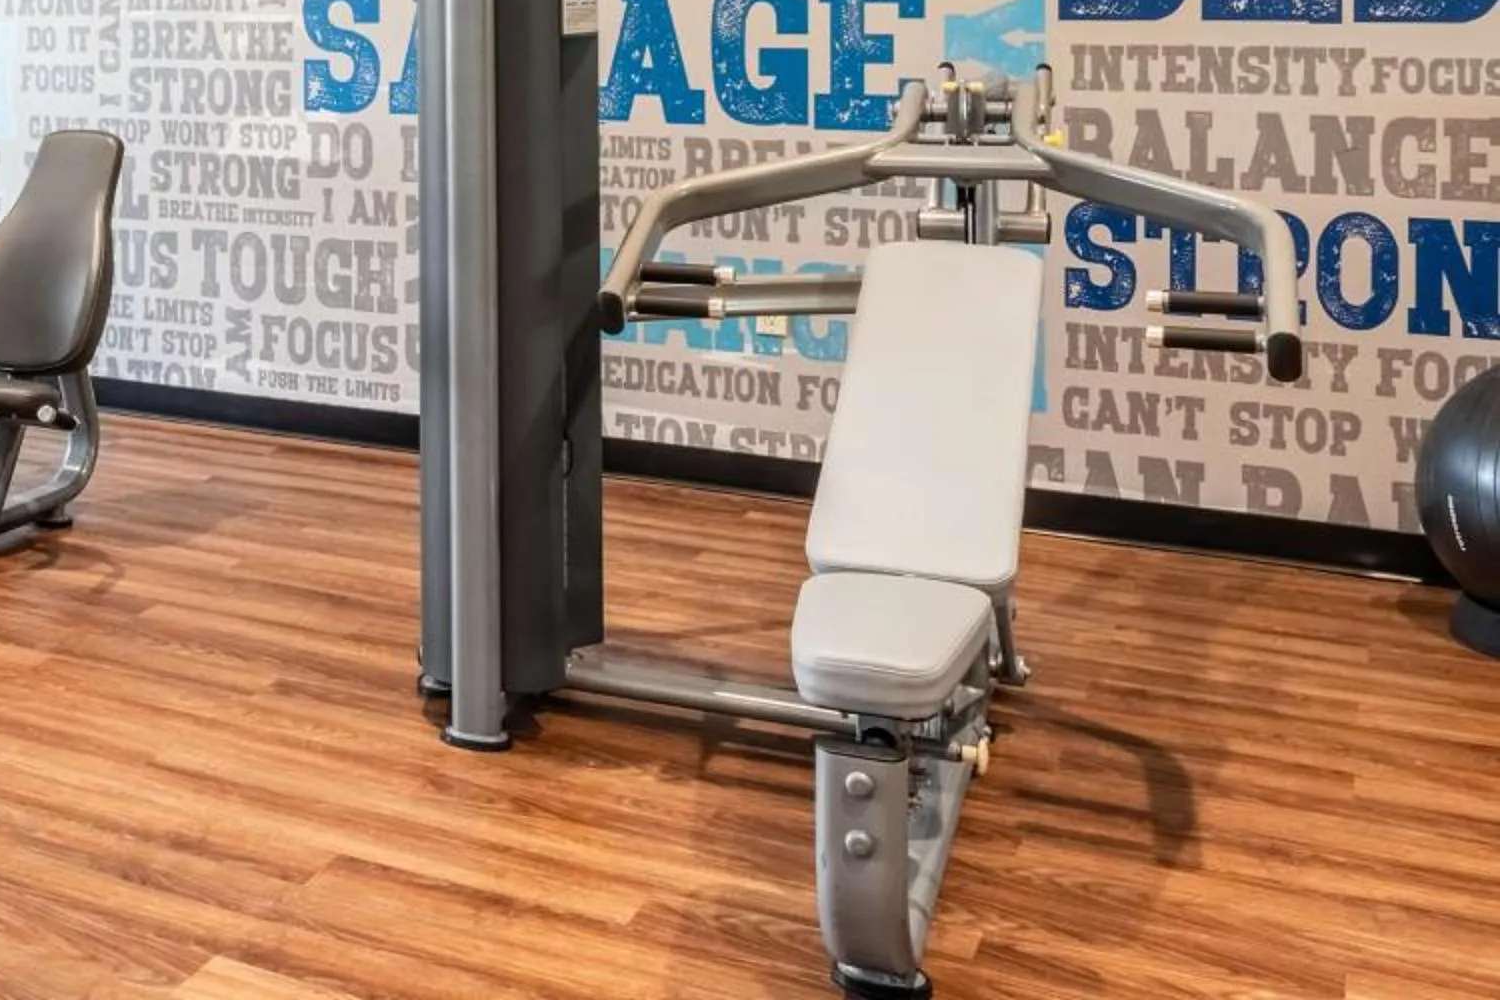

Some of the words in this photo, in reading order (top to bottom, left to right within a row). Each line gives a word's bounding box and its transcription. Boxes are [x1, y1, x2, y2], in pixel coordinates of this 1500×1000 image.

[130, 20, 293, 61] BREATHE
[20, 64, 95, 94] FOCUS
[129, 67, 292, 118] STRONG
[1071, 44, 1365, 97] INTENSITY
[1371, 56, 1500, 97] FOCUS
[240, 122, 297, 150] STOP
[307, 122, 373, 180] DO
[1064, 107, 1500, 202] BALANCE
[151, 150, 300, 199] STRONG
[348, 189, 398, 226] AM
[192, 229, 398, 314] TOUGH
[143, 299, 213, 327] LIMITS
[162, 330, 217, 360] STOP
[260, 315, 398, 374] FOCUS
[1064, 323, 1358, 394] INTENSTY
[604, 354, 780, 406] EDICATION
[1062, 387, 1205, 441] CAN'T
[1230, 401, 1361, 457] STOP
